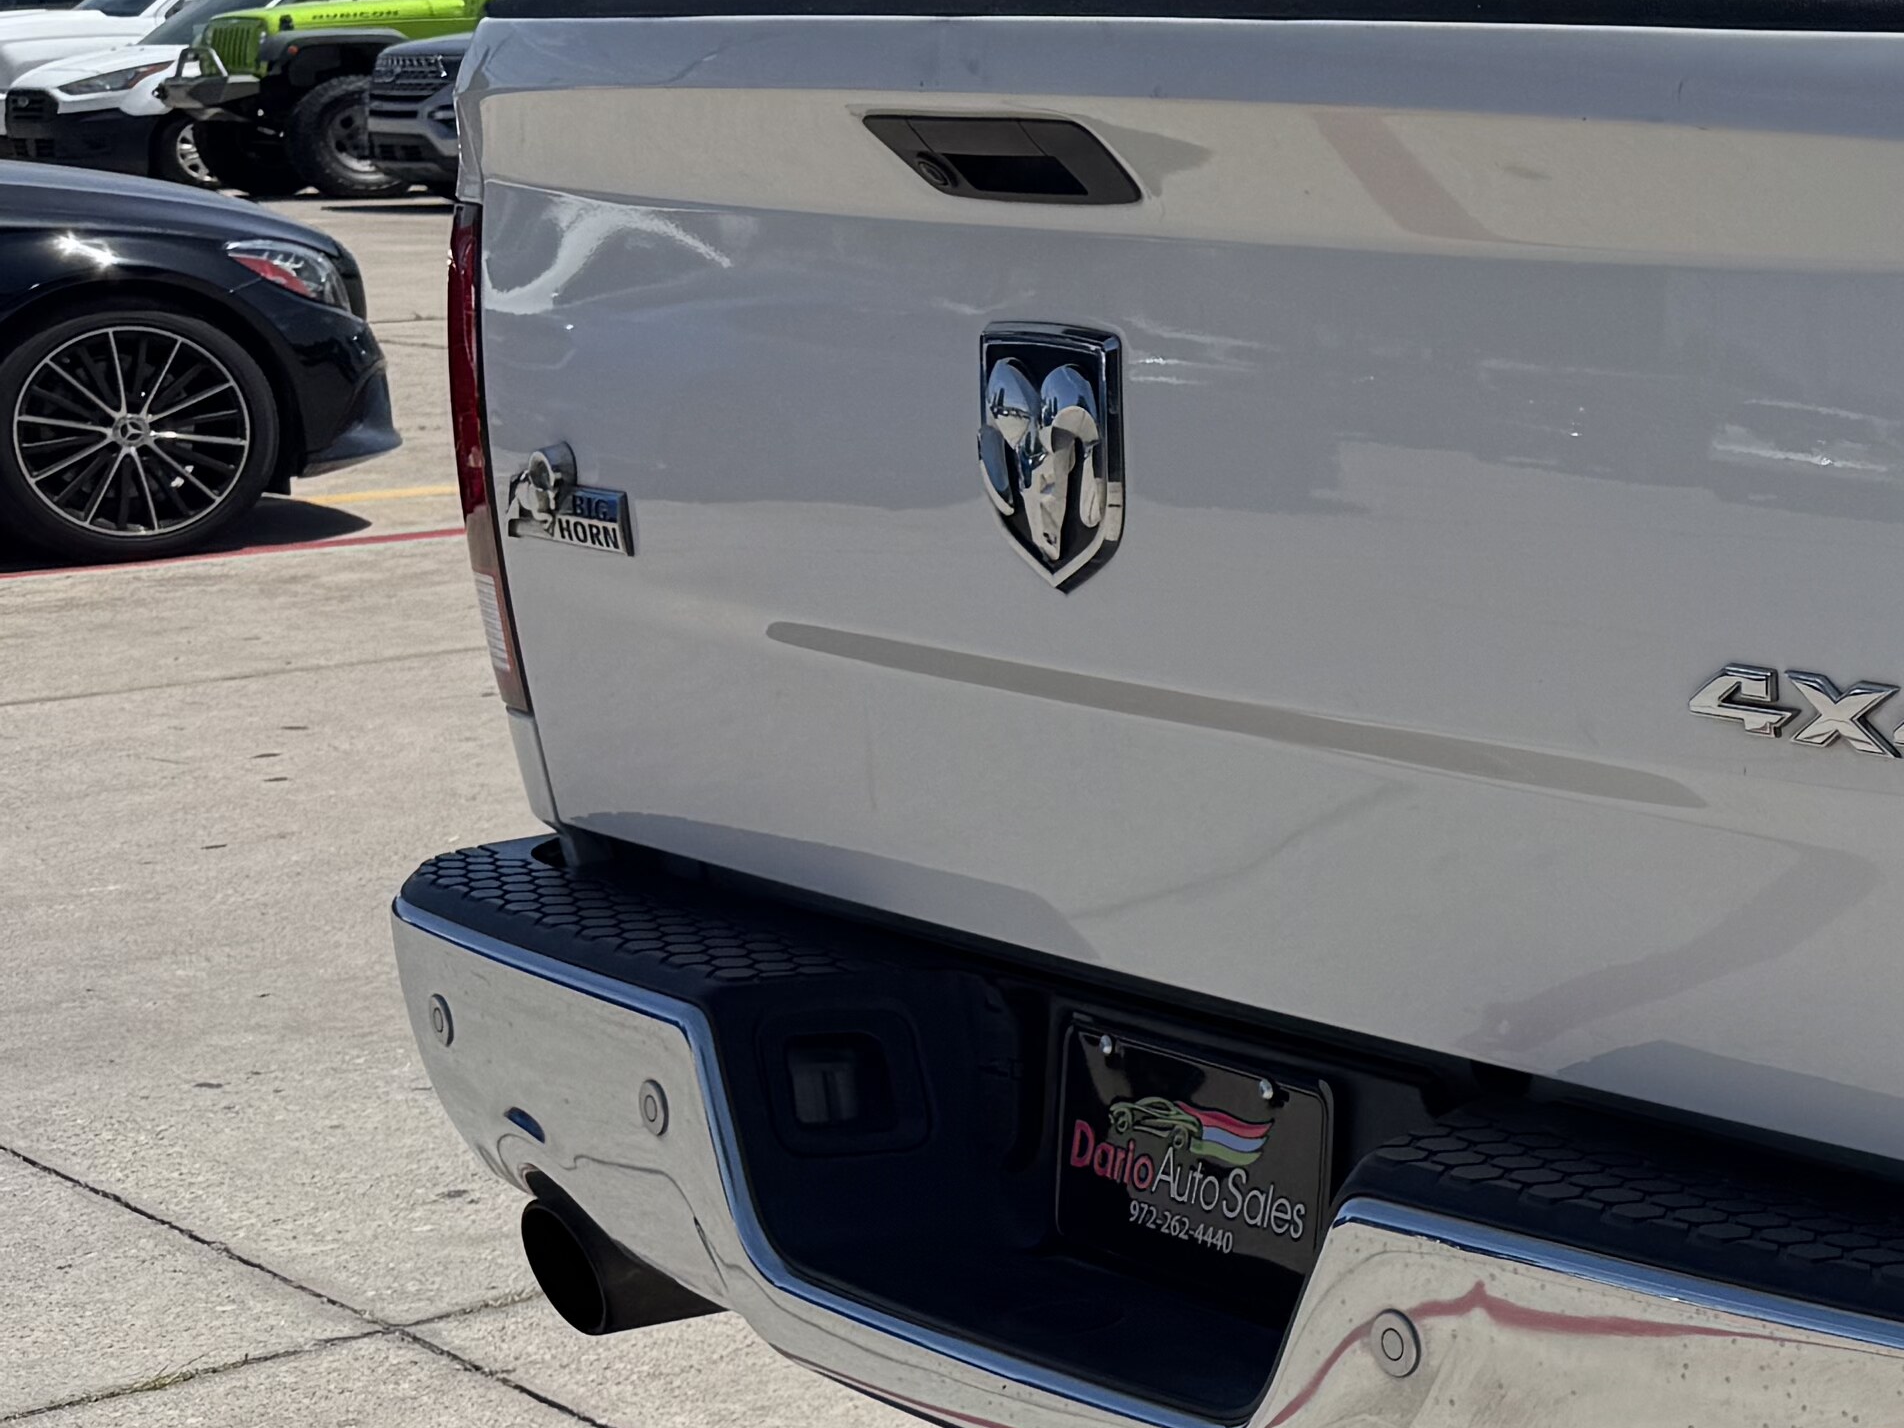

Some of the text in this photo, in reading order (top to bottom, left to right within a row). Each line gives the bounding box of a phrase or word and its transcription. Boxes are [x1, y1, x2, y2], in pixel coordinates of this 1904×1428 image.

[572, 493, 608, 521] BIG
[556, 517, 620, 550] HORN
[1221, 1167, 1306, 1240] Sales
[1129, 1199, 1234, 1254] 972-262-4440
